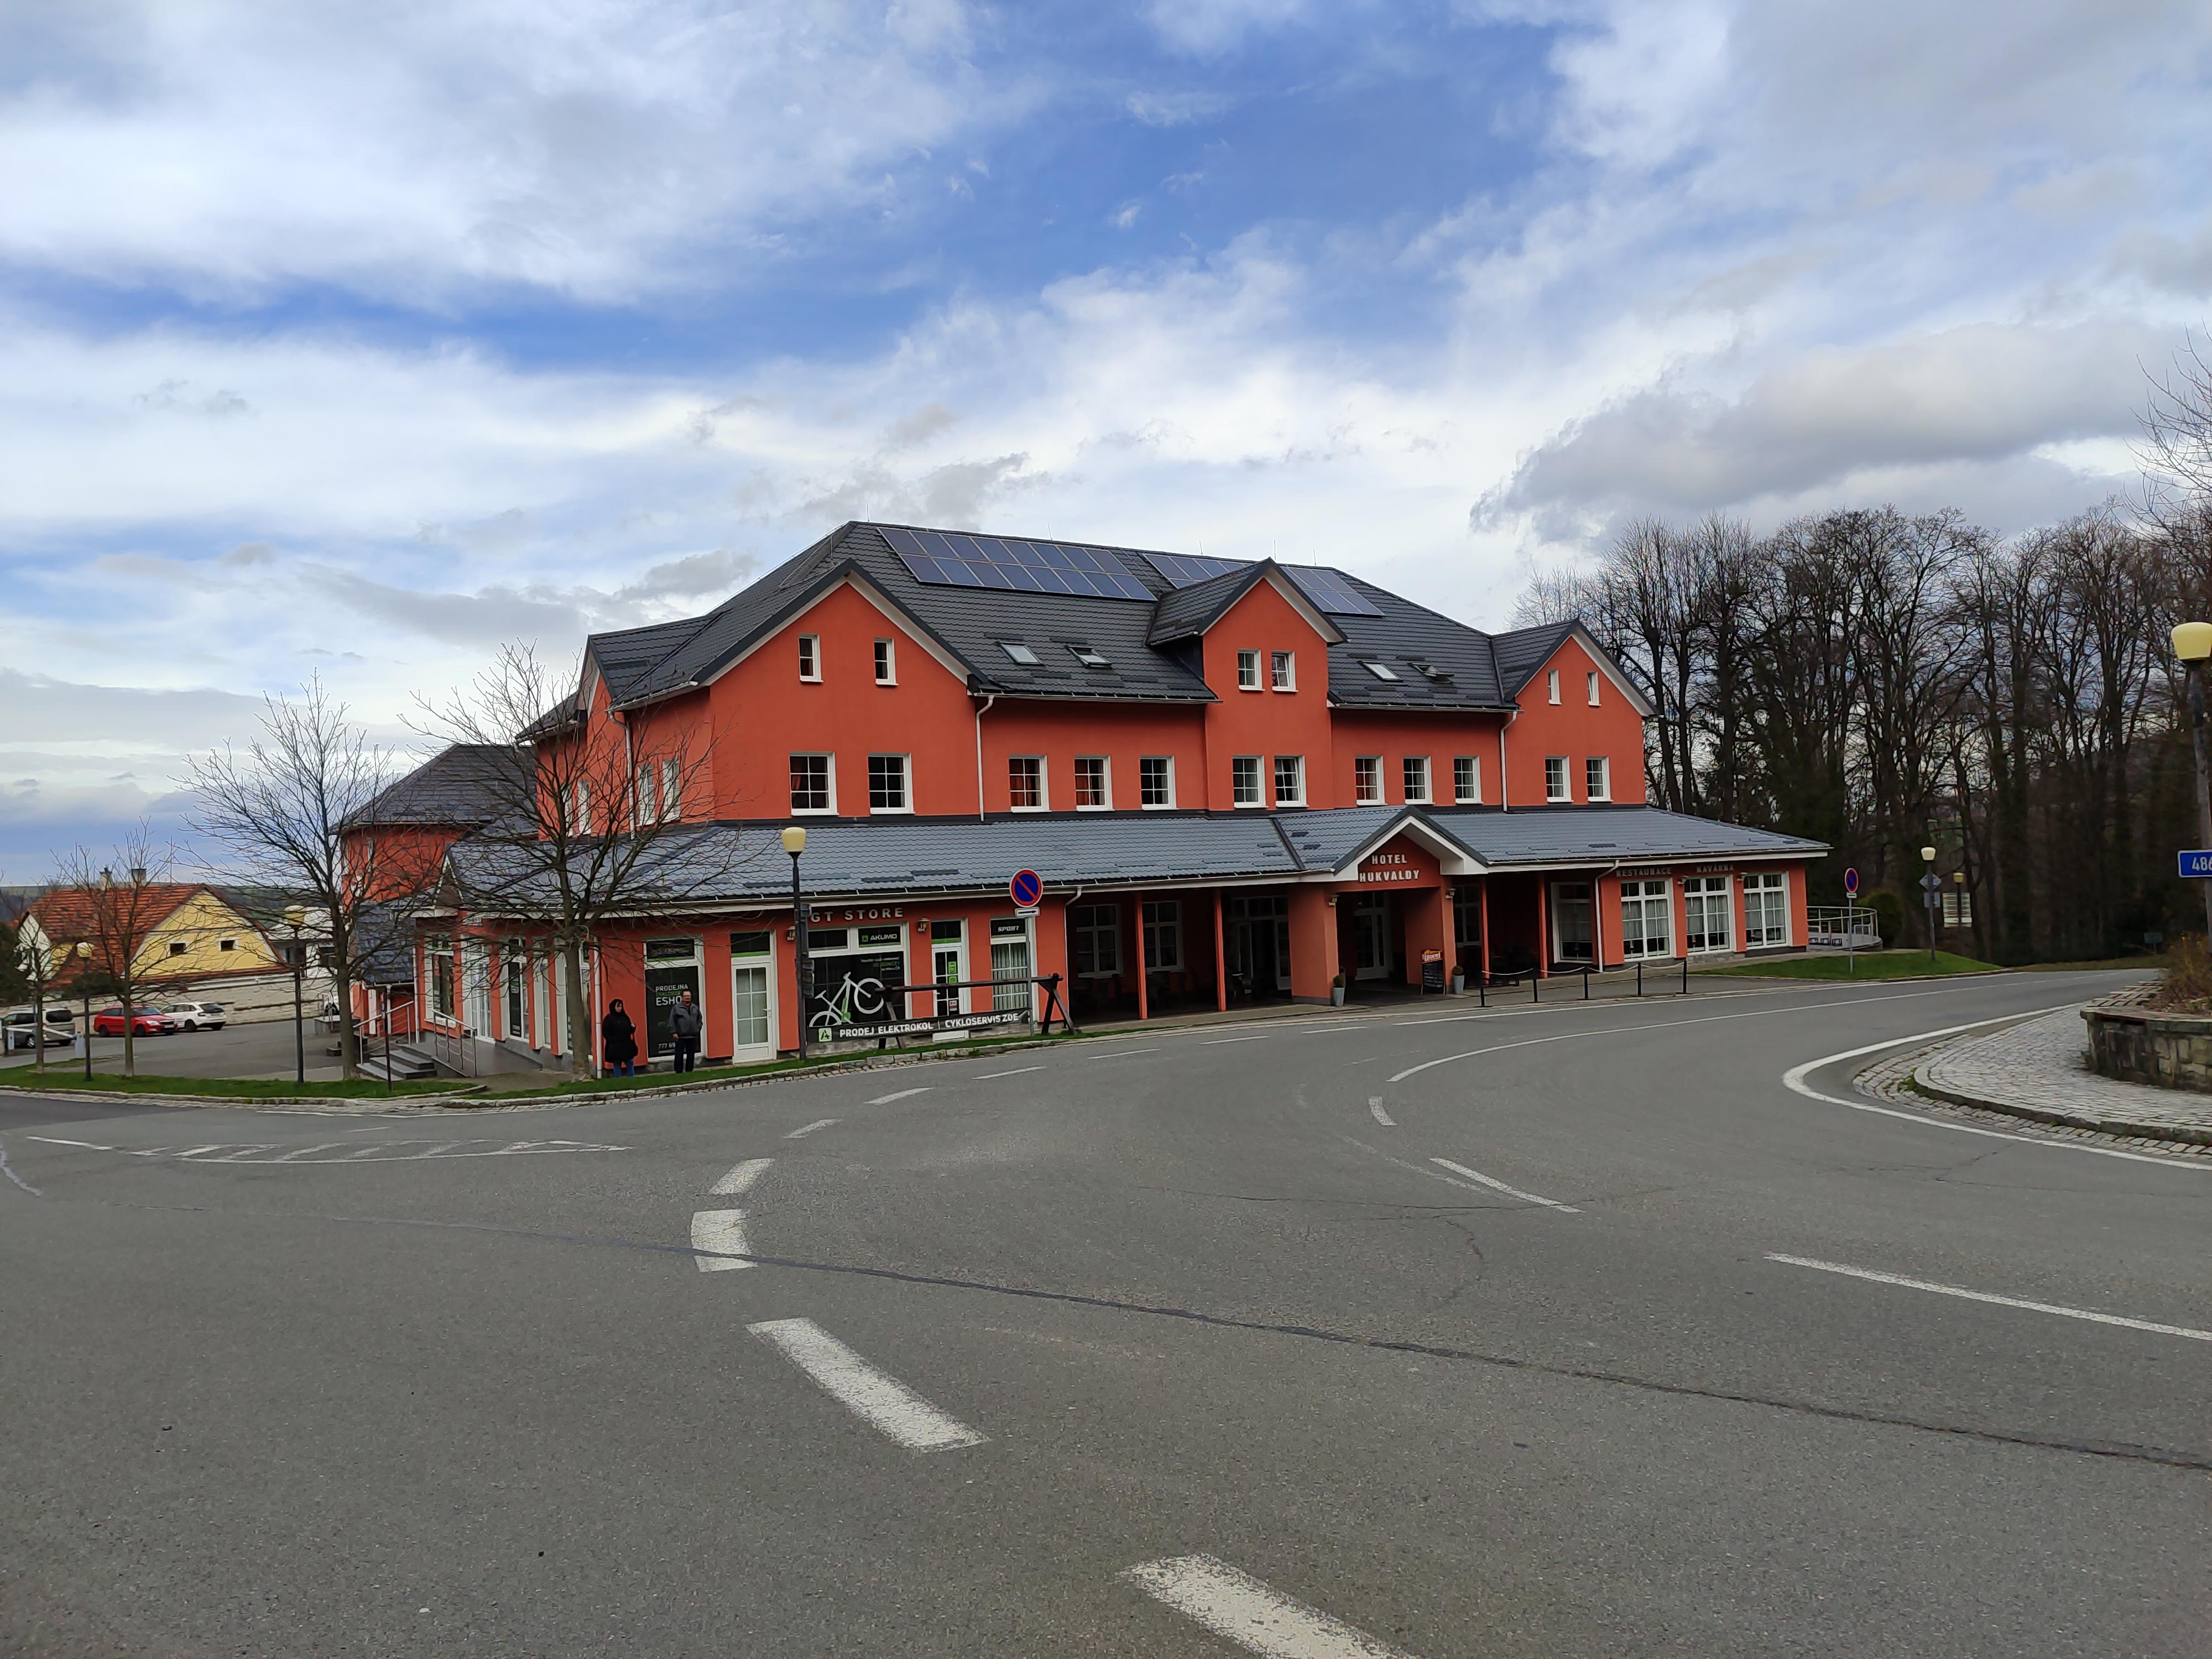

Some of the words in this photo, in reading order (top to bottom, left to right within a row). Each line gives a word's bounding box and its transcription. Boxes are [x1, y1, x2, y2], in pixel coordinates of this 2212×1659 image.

[1372, 854, 1407, 864] HOTEL
[1359, 870, 1420, 882] HUKVALDY
[1616, 867, 1672, 877] RESTAURACE
[844, 907, 903, 920] STORE
[655, 983, 688, 992] PRODEJNA
[656, 995, 682, 1006] ESHO
[945, 1015, 1000, 1028] CYKLOSERVIS
[1001, 1013, 1019, 1022] ZDE
[839, 1026, 874, 1037] PRODEJ
[878, 1022, 933, 1034] ELEKTROKOL
